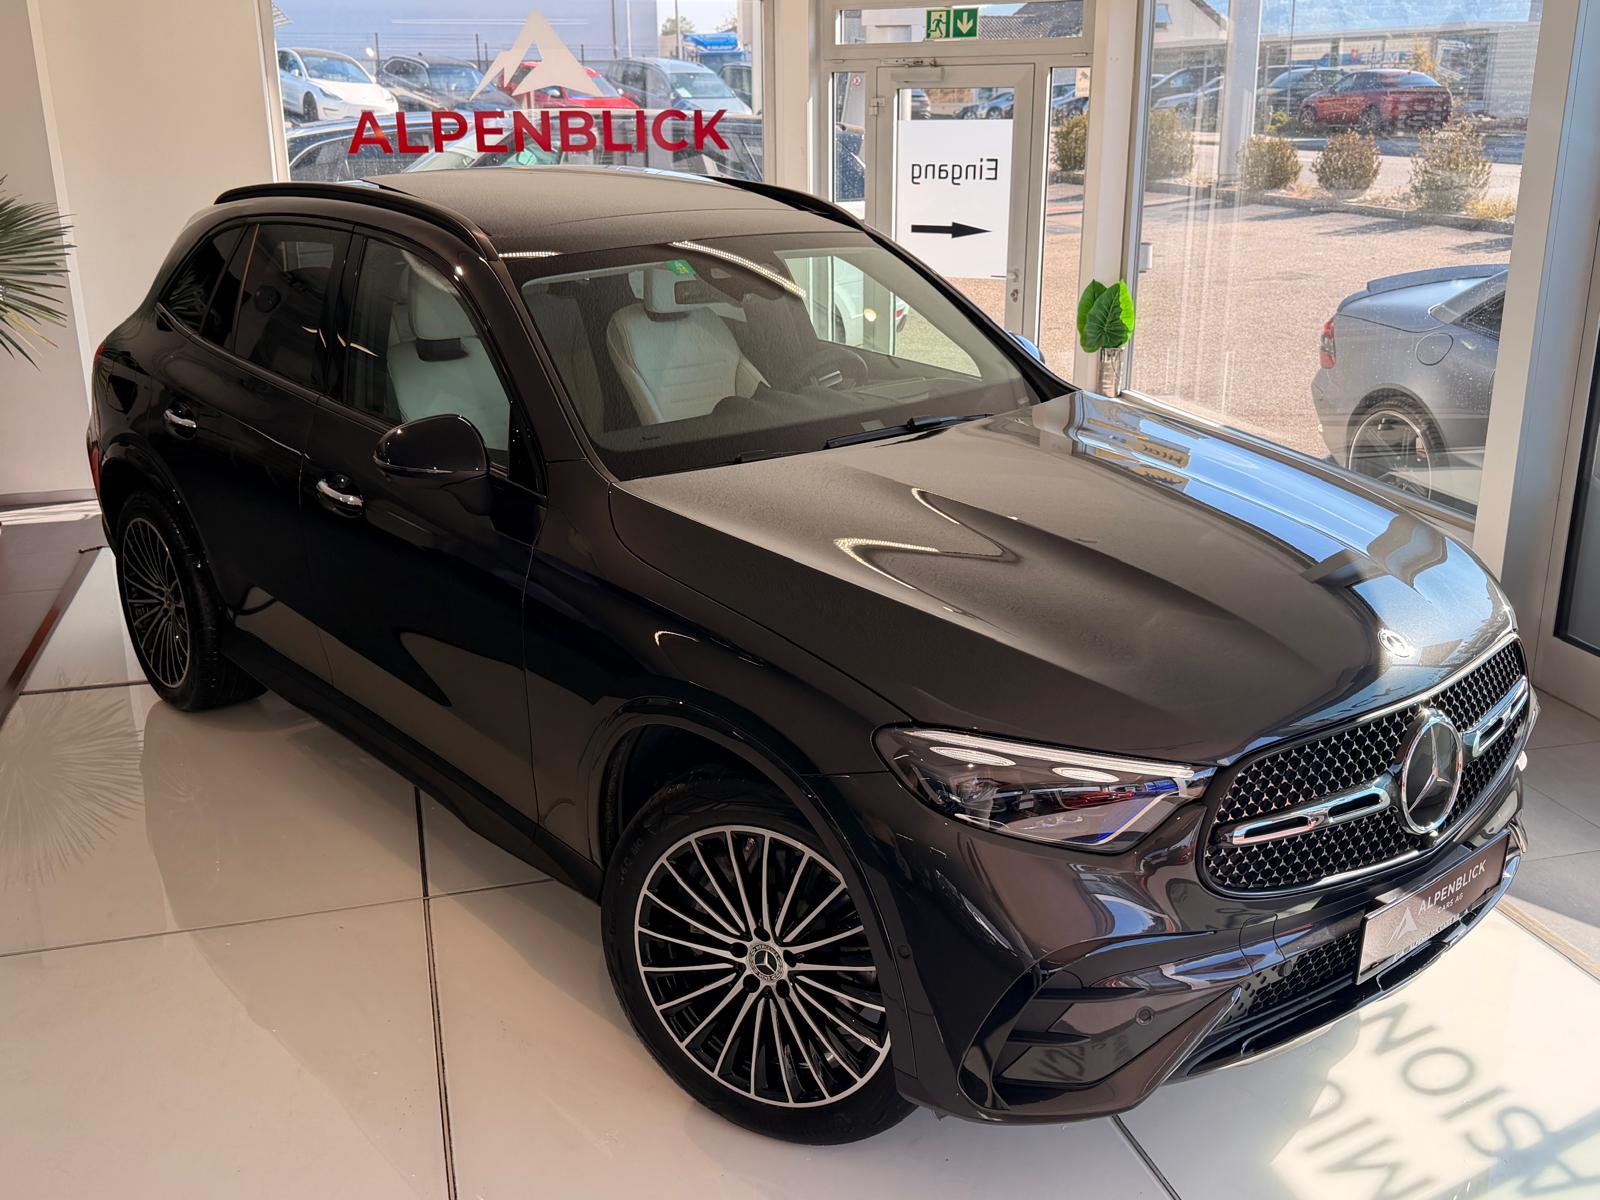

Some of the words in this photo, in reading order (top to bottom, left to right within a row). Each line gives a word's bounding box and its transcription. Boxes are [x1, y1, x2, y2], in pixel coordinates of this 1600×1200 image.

[349, 108, 730, 154] ALPENBLICK
[1418, 859, 1487, 914] ALPENBLICK
[1437, 898, 1454, 914] CARS
